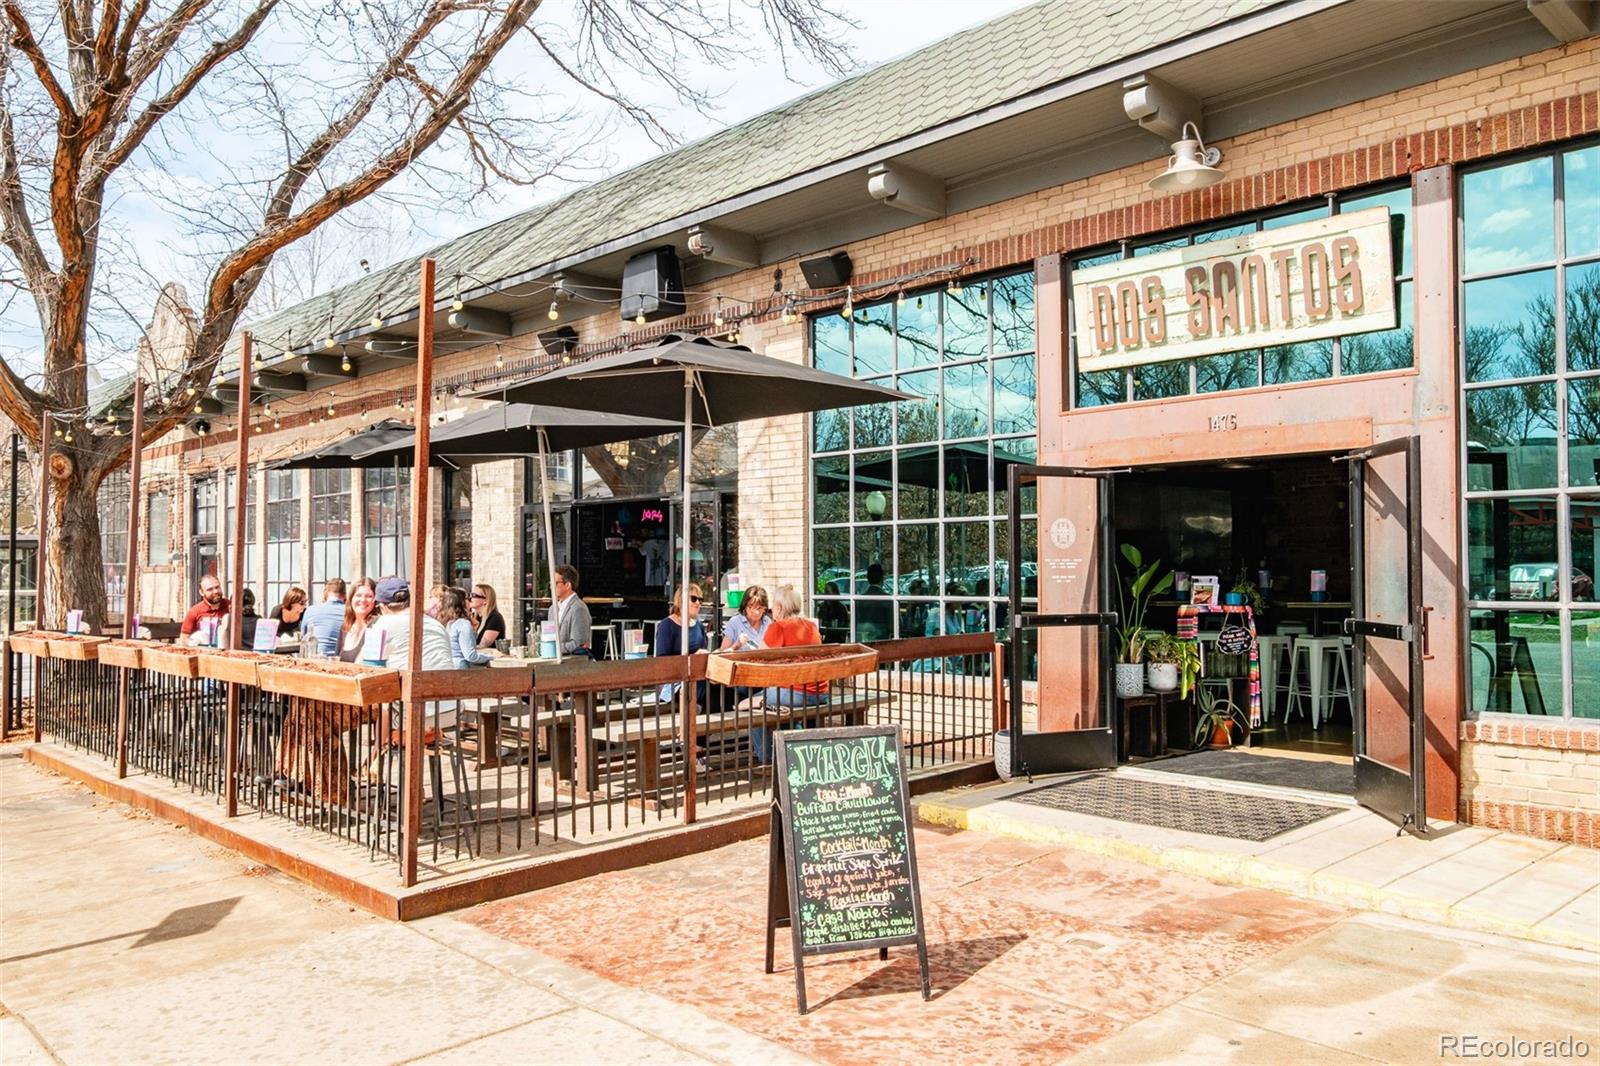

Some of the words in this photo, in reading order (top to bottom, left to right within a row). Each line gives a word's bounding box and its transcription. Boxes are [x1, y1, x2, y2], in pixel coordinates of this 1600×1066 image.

[1092, 275, 1166, 352] DOS
[1184, 236, 1364, 336] SANTOS
[1208, 414, 1237, 432] 1475
[794, 736, 890, 784] MARCH
[817, 912, 843, 927] Casa
[847, 907, 881, 921] Noble
